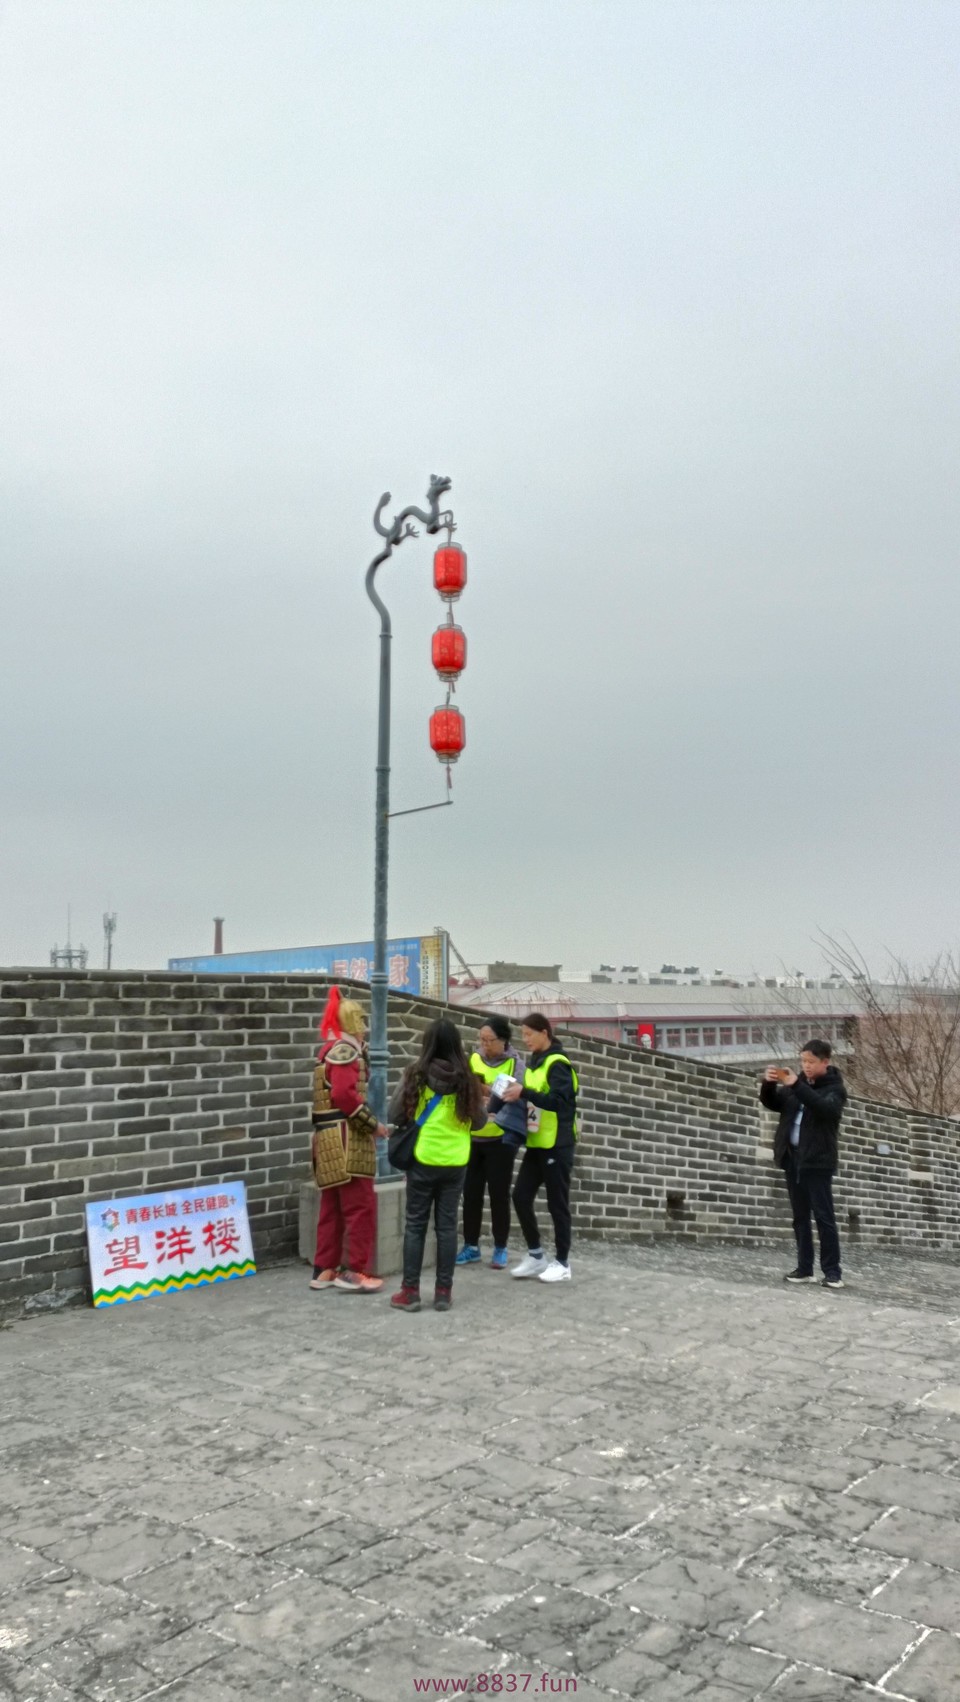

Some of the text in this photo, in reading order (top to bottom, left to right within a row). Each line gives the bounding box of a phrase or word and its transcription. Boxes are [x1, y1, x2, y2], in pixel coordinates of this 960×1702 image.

[126, 1202, 178, 1224] 青春长城
[104, 1217, 241, 1276] 望洋楼
